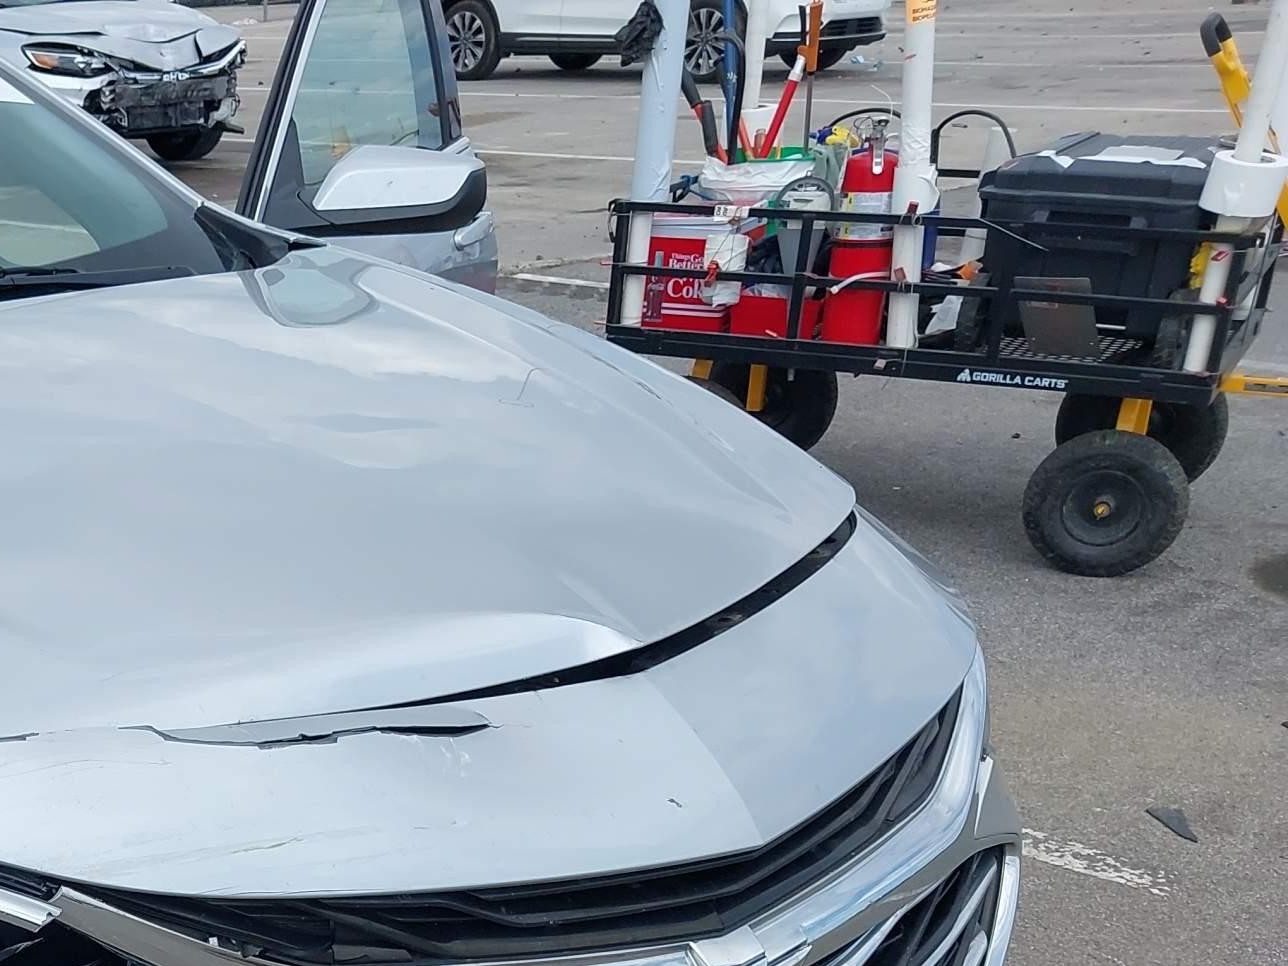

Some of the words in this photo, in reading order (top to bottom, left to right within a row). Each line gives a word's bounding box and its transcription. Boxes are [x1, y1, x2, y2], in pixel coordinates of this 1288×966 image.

[667, 278, 702, 298] Cok
[973, 371, 1021, 385] GORILLA
[1024, 376, 1066, 389] CARTS
